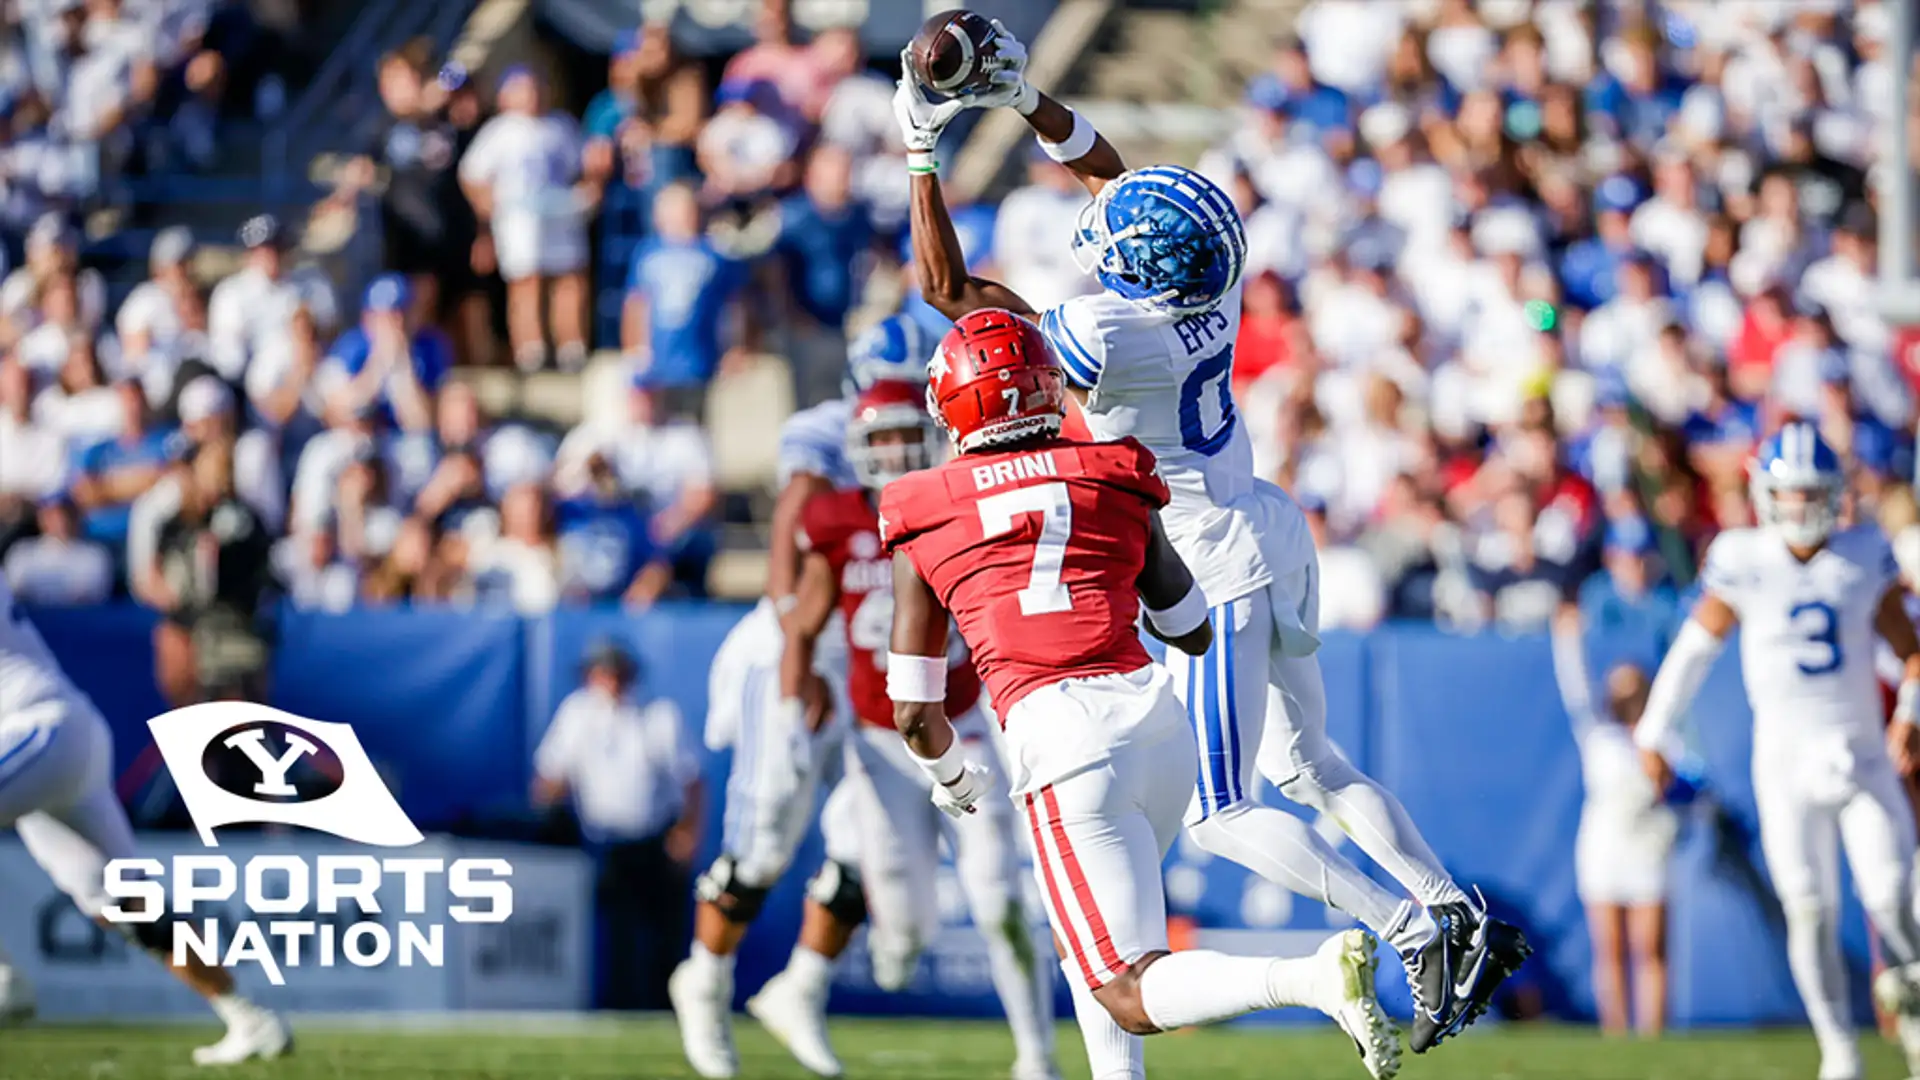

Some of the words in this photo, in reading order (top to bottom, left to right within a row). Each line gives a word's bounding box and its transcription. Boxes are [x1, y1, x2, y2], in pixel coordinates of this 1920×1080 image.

[1001, 387, 1020, 416] 7
[1178, 342, 1236, 457] 0
[972, 451, 1058, 492] BRINI
[976, 482, 1073, 616] 7
[1790, 602, 1843, 675] 3
